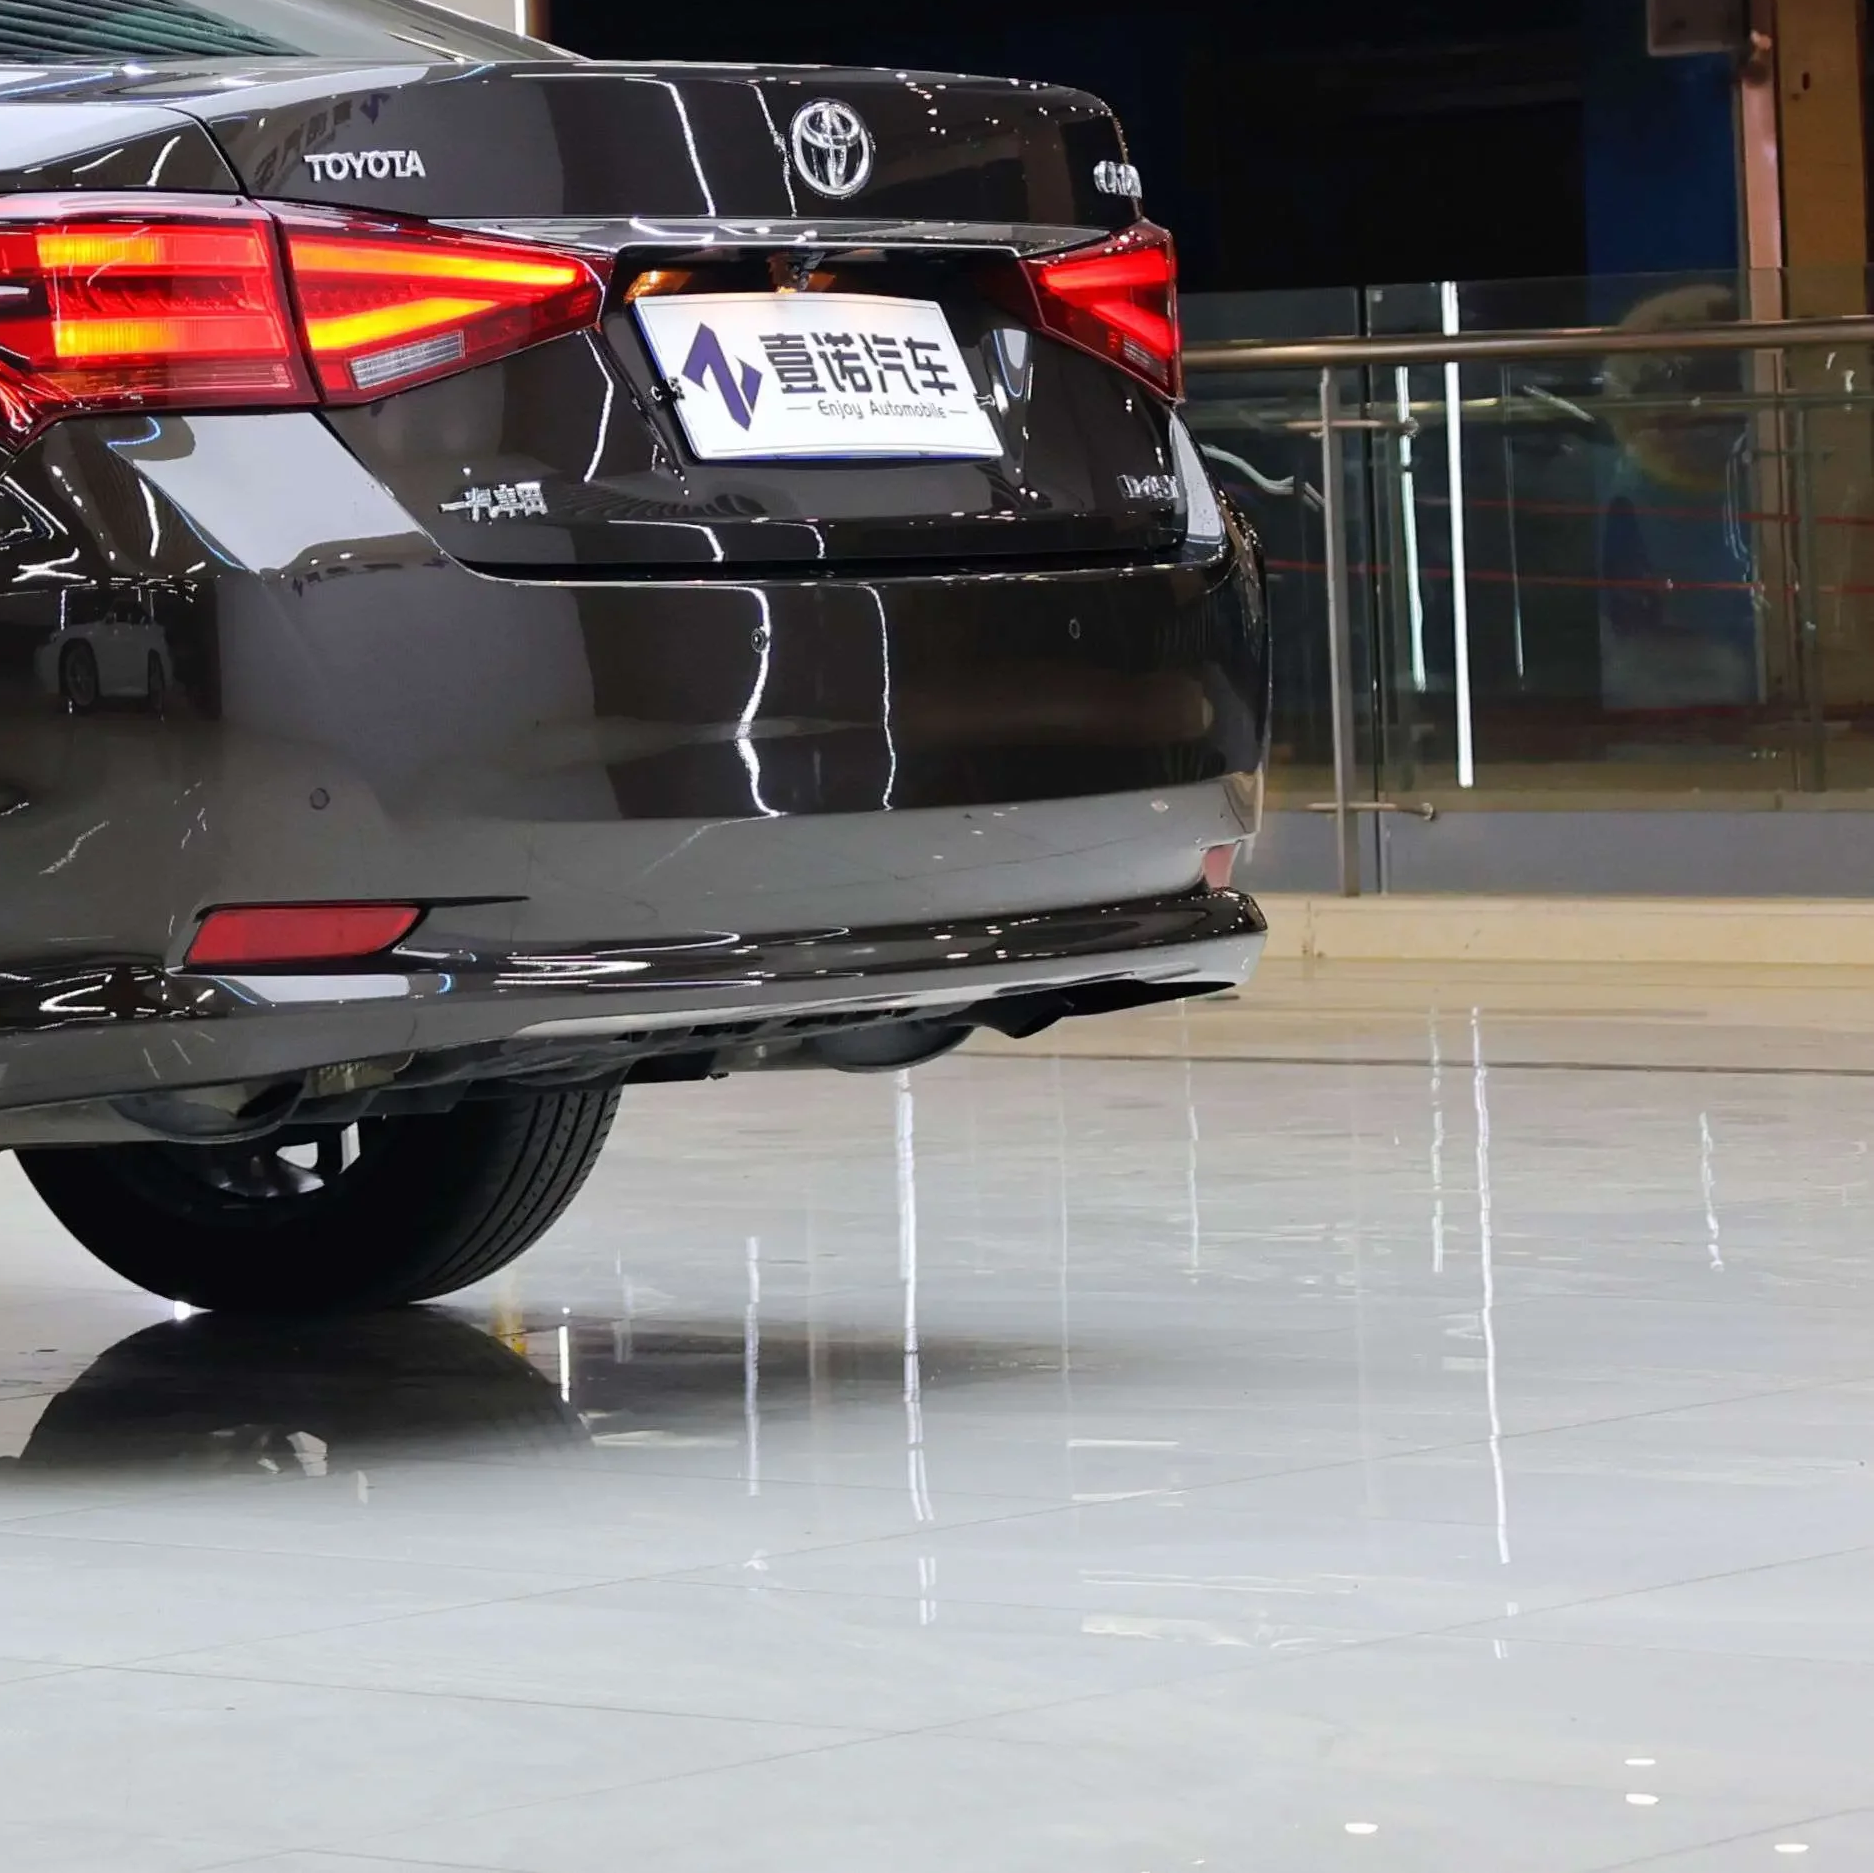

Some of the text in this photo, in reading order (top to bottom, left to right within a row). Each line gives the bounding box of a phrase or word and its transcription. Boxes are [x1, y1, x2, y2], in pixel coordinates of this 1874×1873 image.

[304, 149, 426, 182] TOYOTA
[758, 331, 959, 397] 壹诺汽车
[818, 398, 947, 419] Enjoy Automobile
